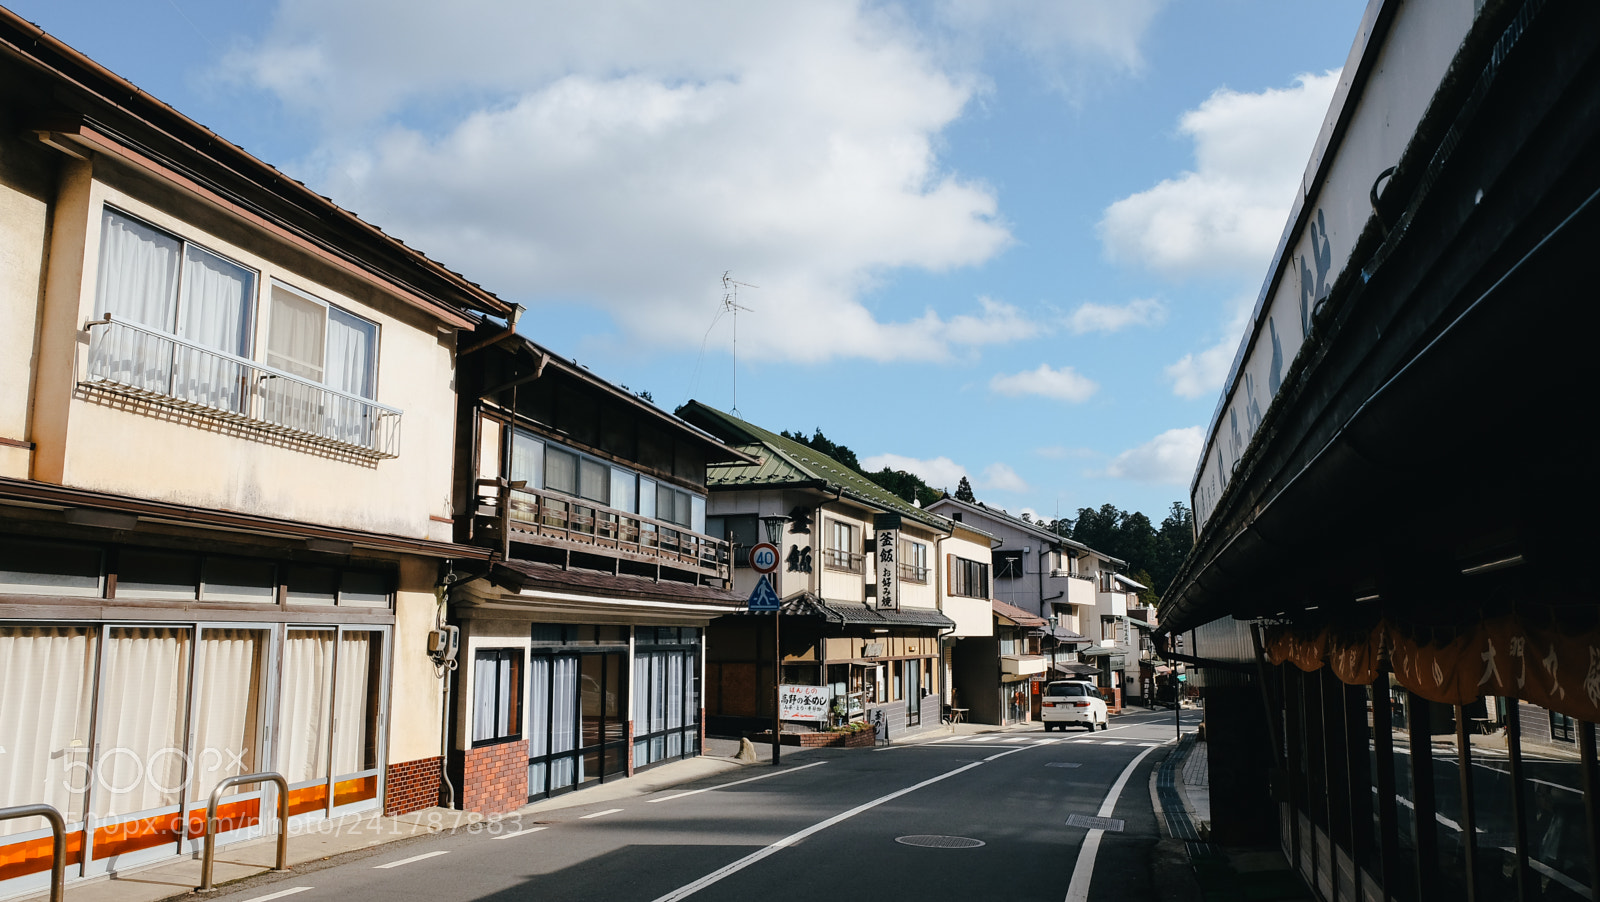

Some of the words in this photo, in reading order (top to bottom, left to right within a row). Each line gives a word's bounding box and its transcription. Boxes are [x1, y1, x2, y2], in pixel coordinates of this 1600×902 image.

[756, 551, 773, 566] 40
[780, 693, 827, 706] 高野の釜めし
